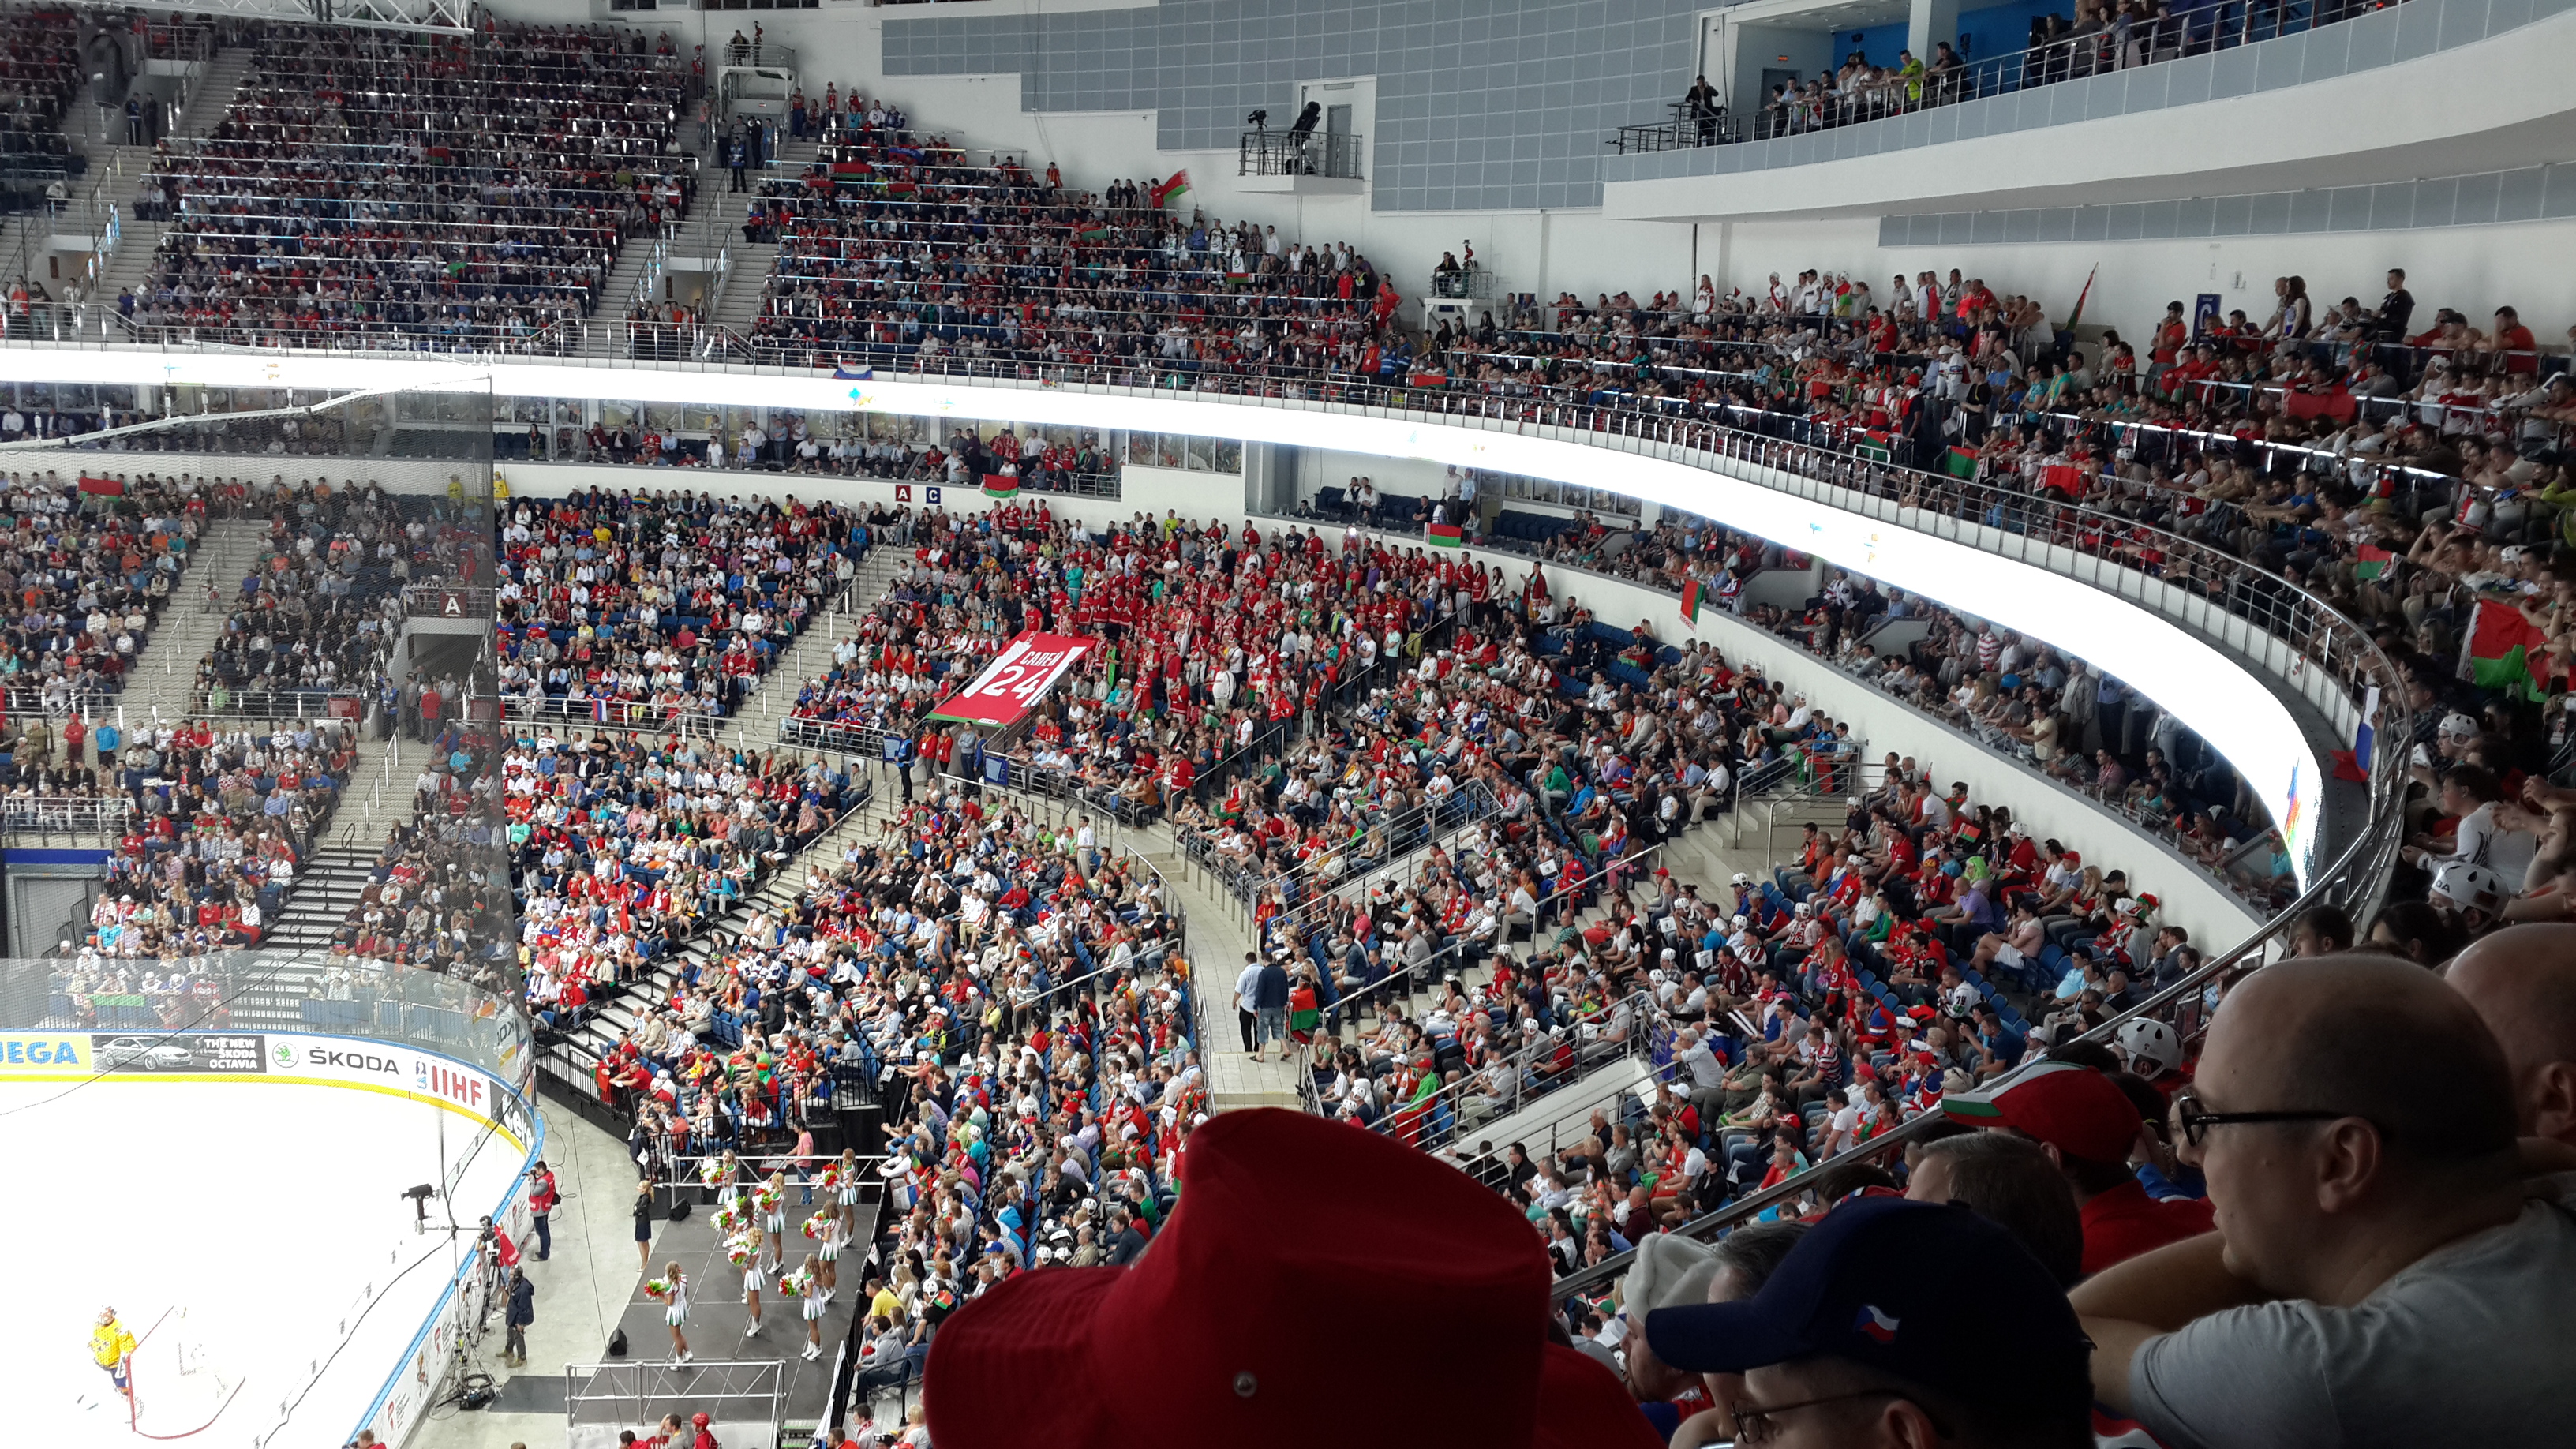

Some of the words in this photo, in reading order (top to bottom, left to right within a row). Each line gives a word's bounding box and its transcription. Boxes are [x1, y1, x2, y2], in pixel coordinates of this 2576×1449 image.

[898, 488, 908, 499] A
[928, 490, 938, 501] C
[444, 597, 462, 614] A
[980, 665, 1049, 700] 24
[1831, 972, 1838, 983] 9
[204, 1038, 227, 1048] THE
[230, 1038, 256, 1048] NEW
[218, 1047, 257, 1058] ŠKODA
[209, 1059, 258, 1069] OCTAVIA
[309, 1046, 400, 1075] ŠKODA
[432, 1065, 482, 1106] IIHF
